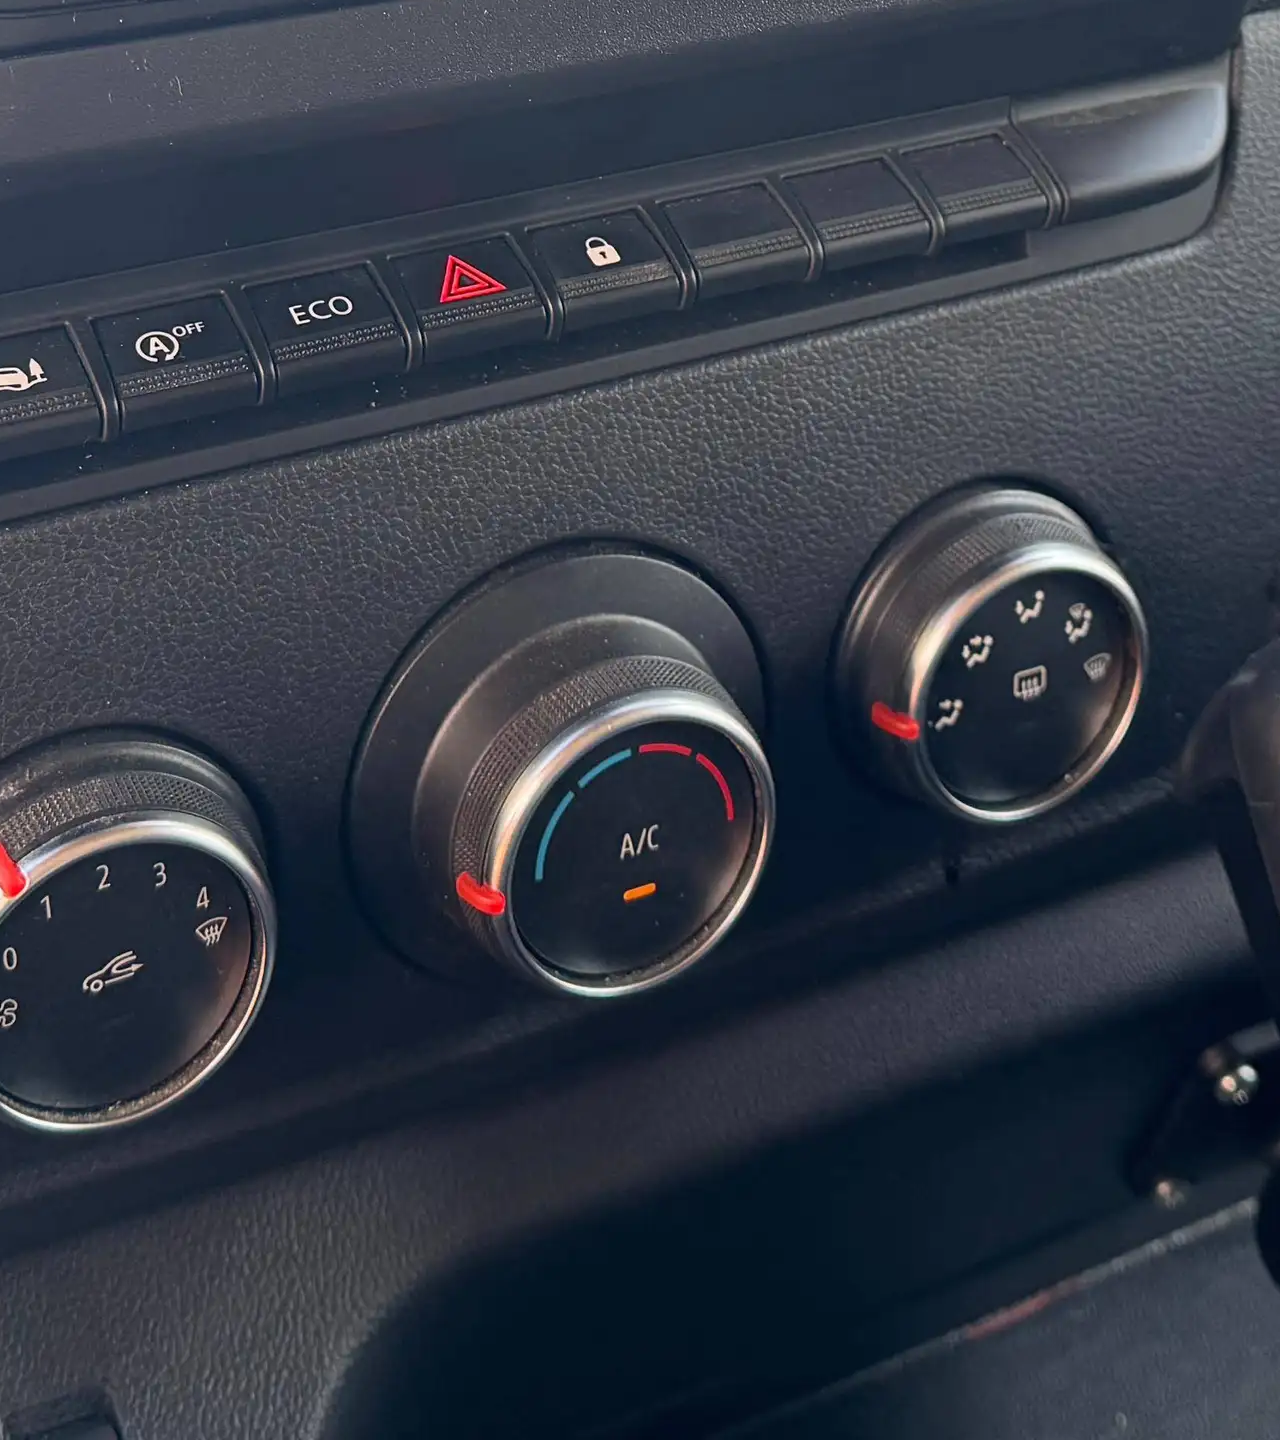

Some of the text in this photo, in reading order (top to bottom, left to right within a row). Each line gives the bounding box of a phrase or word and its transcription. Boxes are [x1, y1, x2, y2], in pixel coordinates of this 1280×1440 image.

[288, 295, 353, 325] ECO
[172, 320, 206, 338] OFF
[619, 824, 659, 860] A/C
[96, 864, 111, 891] 2
[153, 862, 167, 888] 3
[40, 895, 52, 919] 1
[196, 886, 210, 909] 4
[2, 946, 18, 971] 0
